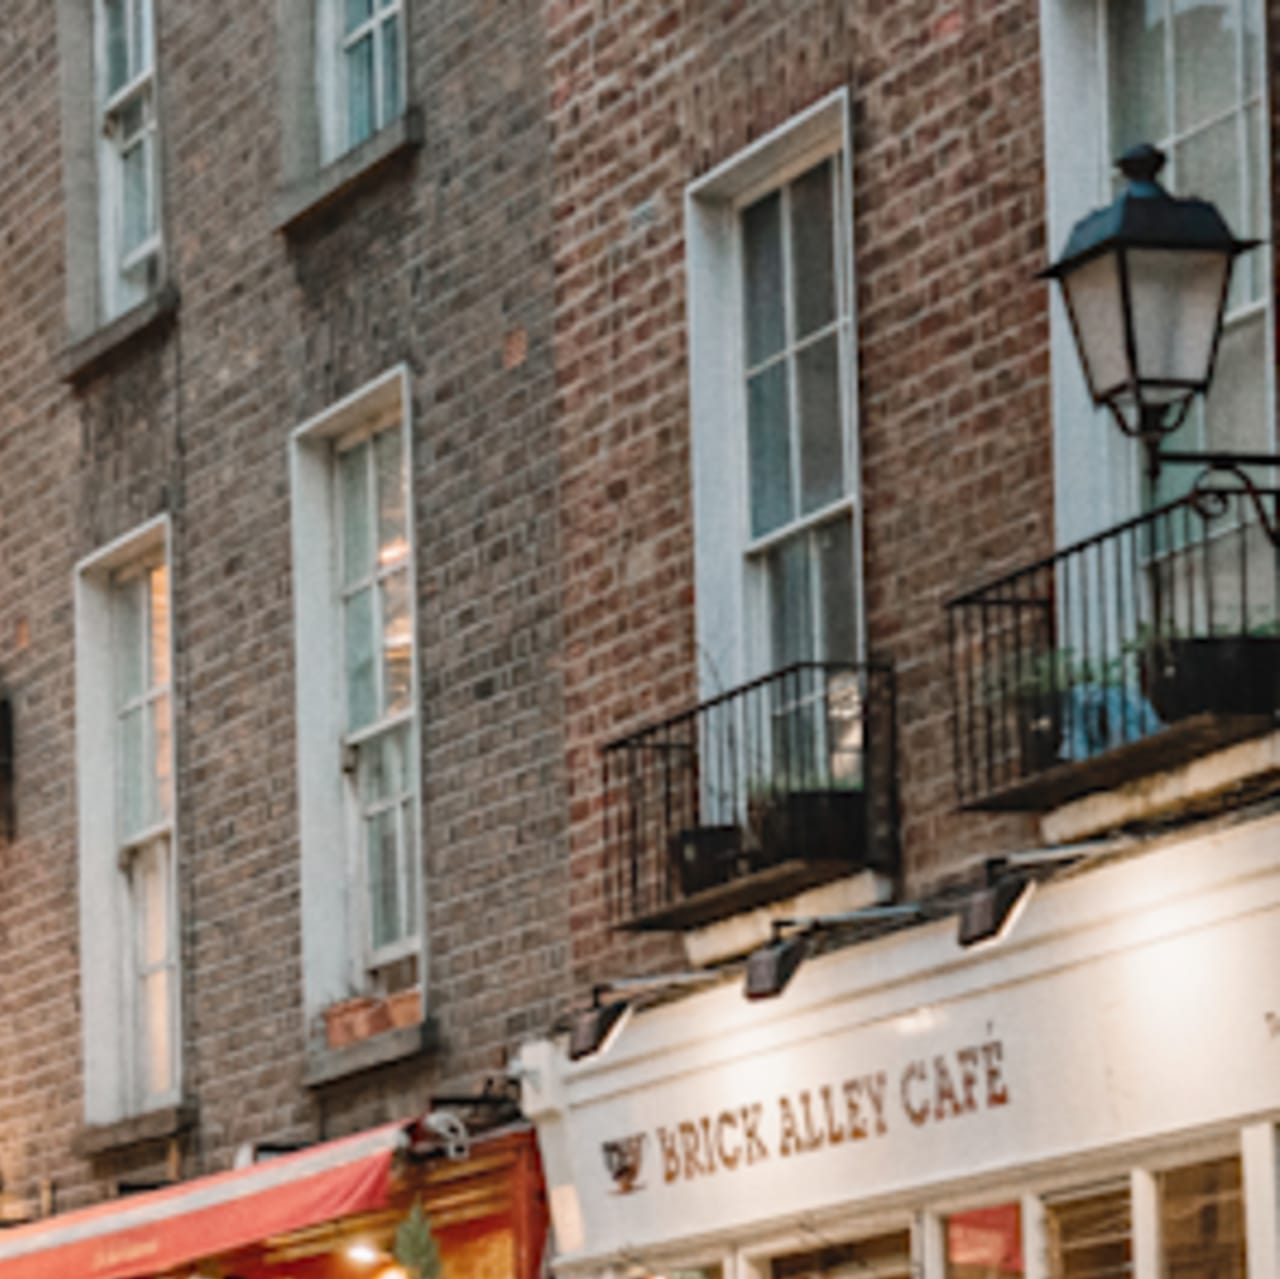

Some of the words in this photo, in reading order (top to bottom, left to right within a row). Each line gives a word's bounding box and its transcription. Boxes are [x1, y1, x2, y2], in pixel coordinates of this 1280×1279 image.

[654, 1102, 770, 1186] BRICK
[778, 1070, 890, 1158] ALLEY
[900, 1021, 1011, 1128] CAFÉ
